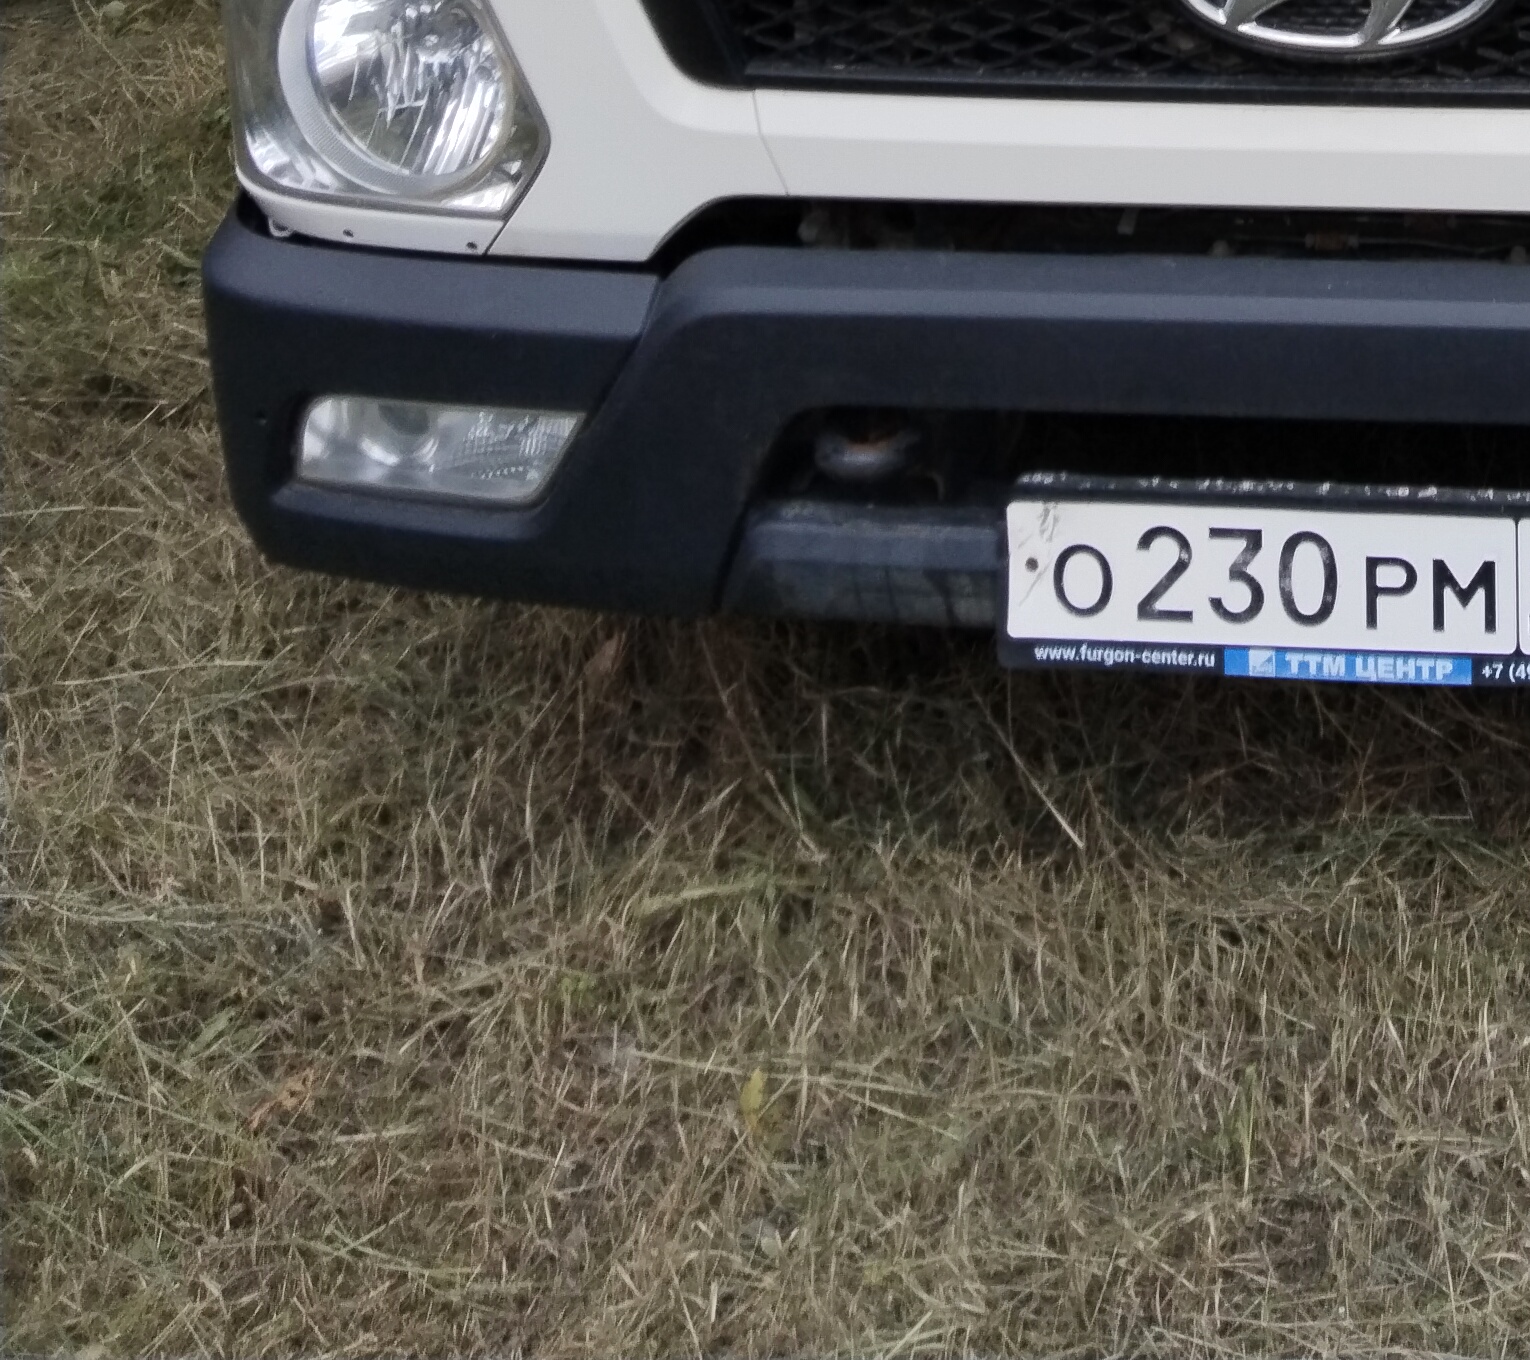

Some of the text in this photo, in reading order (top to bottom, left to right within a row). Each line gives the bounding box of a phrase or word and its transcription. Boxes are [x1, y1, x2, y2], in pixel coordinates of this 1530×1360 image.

[1034, 642, 1216, 666] www.furgon-center.ru
[1354, 653, 1454, 682] ЦЕНТР
[1481, 664, 1502, 681] +7
